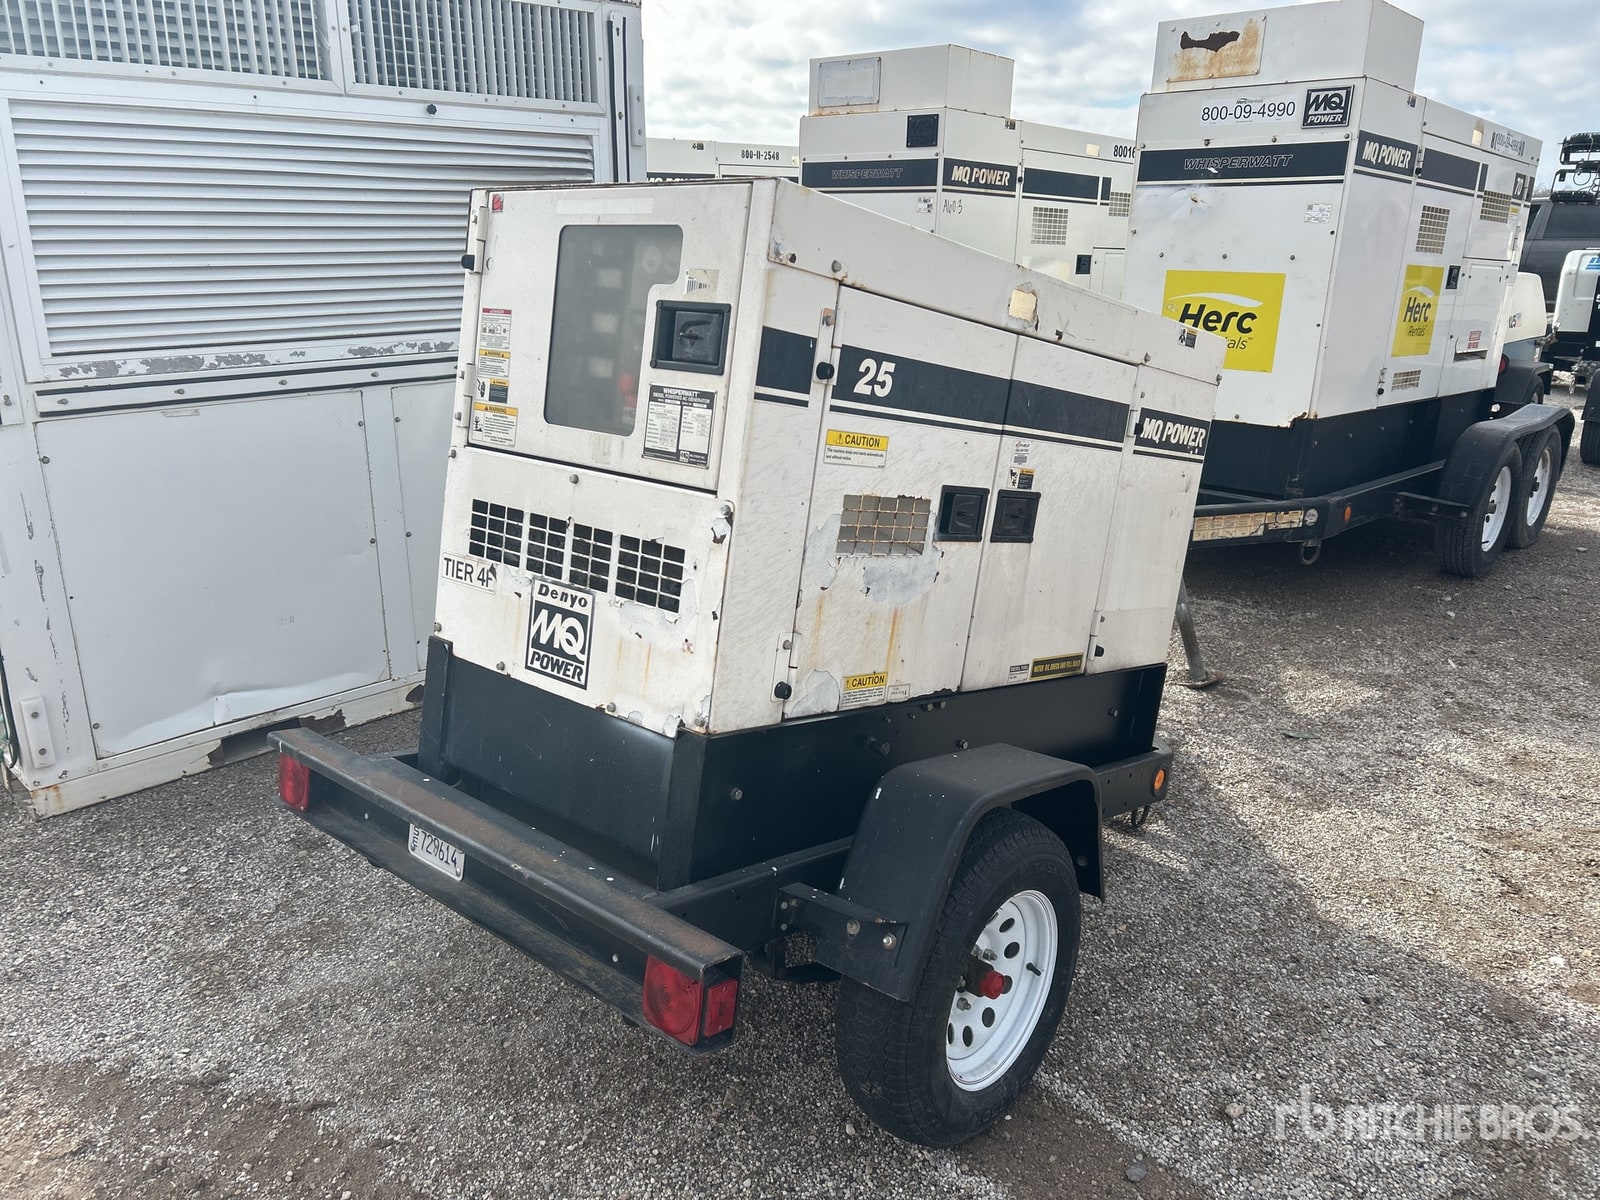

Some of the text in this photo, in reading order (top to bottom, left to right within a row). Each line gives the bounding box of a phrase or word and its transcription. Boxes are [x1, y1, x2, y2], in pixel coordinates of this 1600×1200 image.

[1201, 101, 1296, 122] 800-09-4990
[1309, 92, 1344, 112] MQ
[1307, 113, 1343, 124] POWER
[1184, 154, 1293, 170] WHISPERWATT
[1362, 140, 1411, 169] MQ POWER
[831, 167, 903, 180] WHISPERWATT
[951, 165, 1010, 186] MQ POWER
[1179, 303, 1258, 334] Herc
[1403, 296, 1431, 322] Herc
[853, 358, 896, 397] 25
[845, 434, 880, 448] CAUTION
[1140, 417, 1206, 448] MQ POWER
[443, 557, 474, 584] TIER
[538, 583, 588, 609] Denyo
[531, 609, 586, 661] MQ
[529, 650, 584, 683] POWER
[851, 675, 885, 688] CAUTION
[421, 830, 458, 868] 729614
